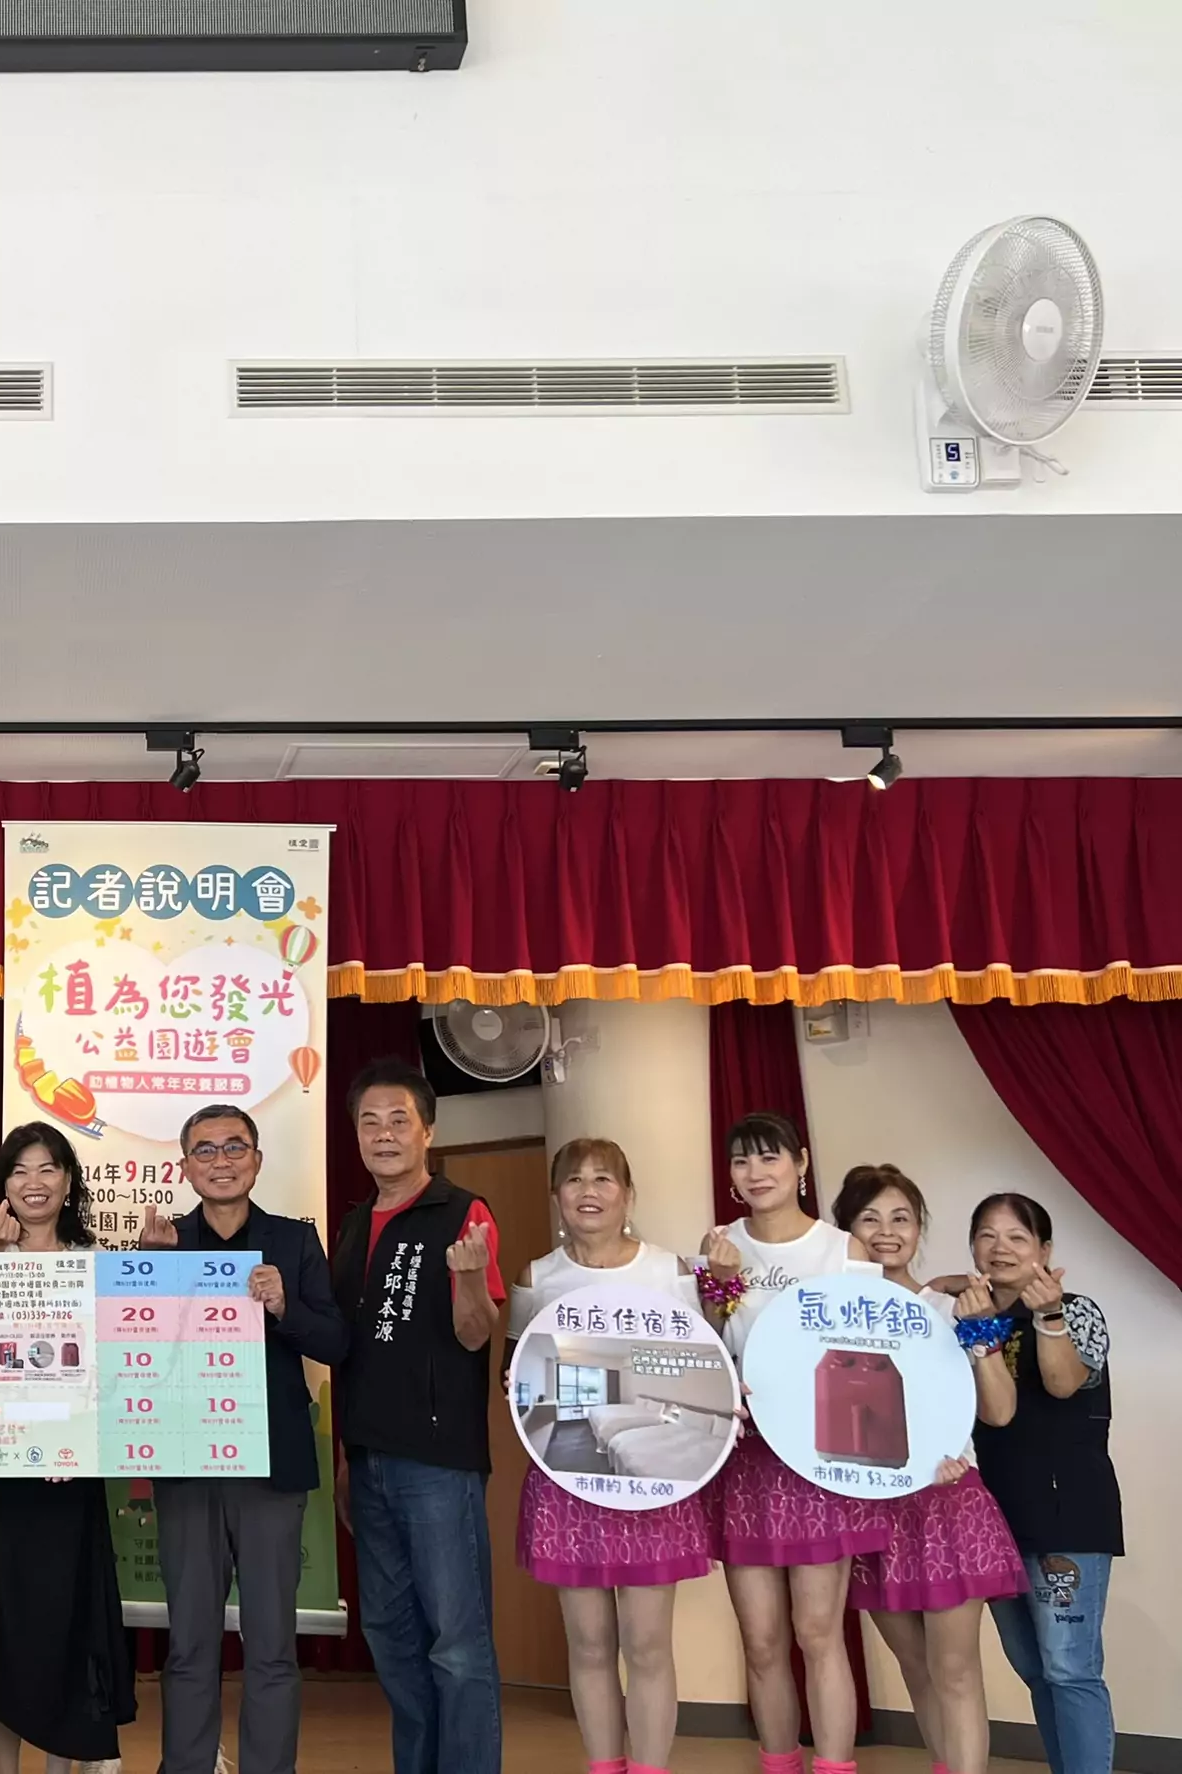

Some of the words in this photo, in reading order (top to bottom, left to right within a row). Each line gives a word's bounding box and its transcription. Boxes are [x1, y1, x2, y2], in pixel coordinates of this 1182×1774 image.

[33, 871, 291, 913] 記者說明會
[38, 959, 294, 1022] 植為您發光
[76, 1027, 255, 1063] 公益園遊會
[121, 1260, 154, 1275] 50
[203, 1261, 236, 1276] 50
[121, 1307, 155, 1322] 20
[203, 1307, 238, 1322] 20
[556, 1304, 691, 1336] 飯店住宿券
[798, 1289, 928, 1336] 氣炸鍋
[123, 1352, 152, 1367] 10
[205, 1352, 234, 1367] 10
[124, 1398, 153, 1412] 10
[207, 1398, 236, 1412] 10
[125, 1444, 155, 1459] 10
[208, 1444, 238, 1459] 10
[813, 1466, 860, 1484] 市價約
[867, 1471, 913, 1488] $3,280
[575, 1477, 621, 1494] 市價約
[629, 1480, 674, 1497] $6,600
